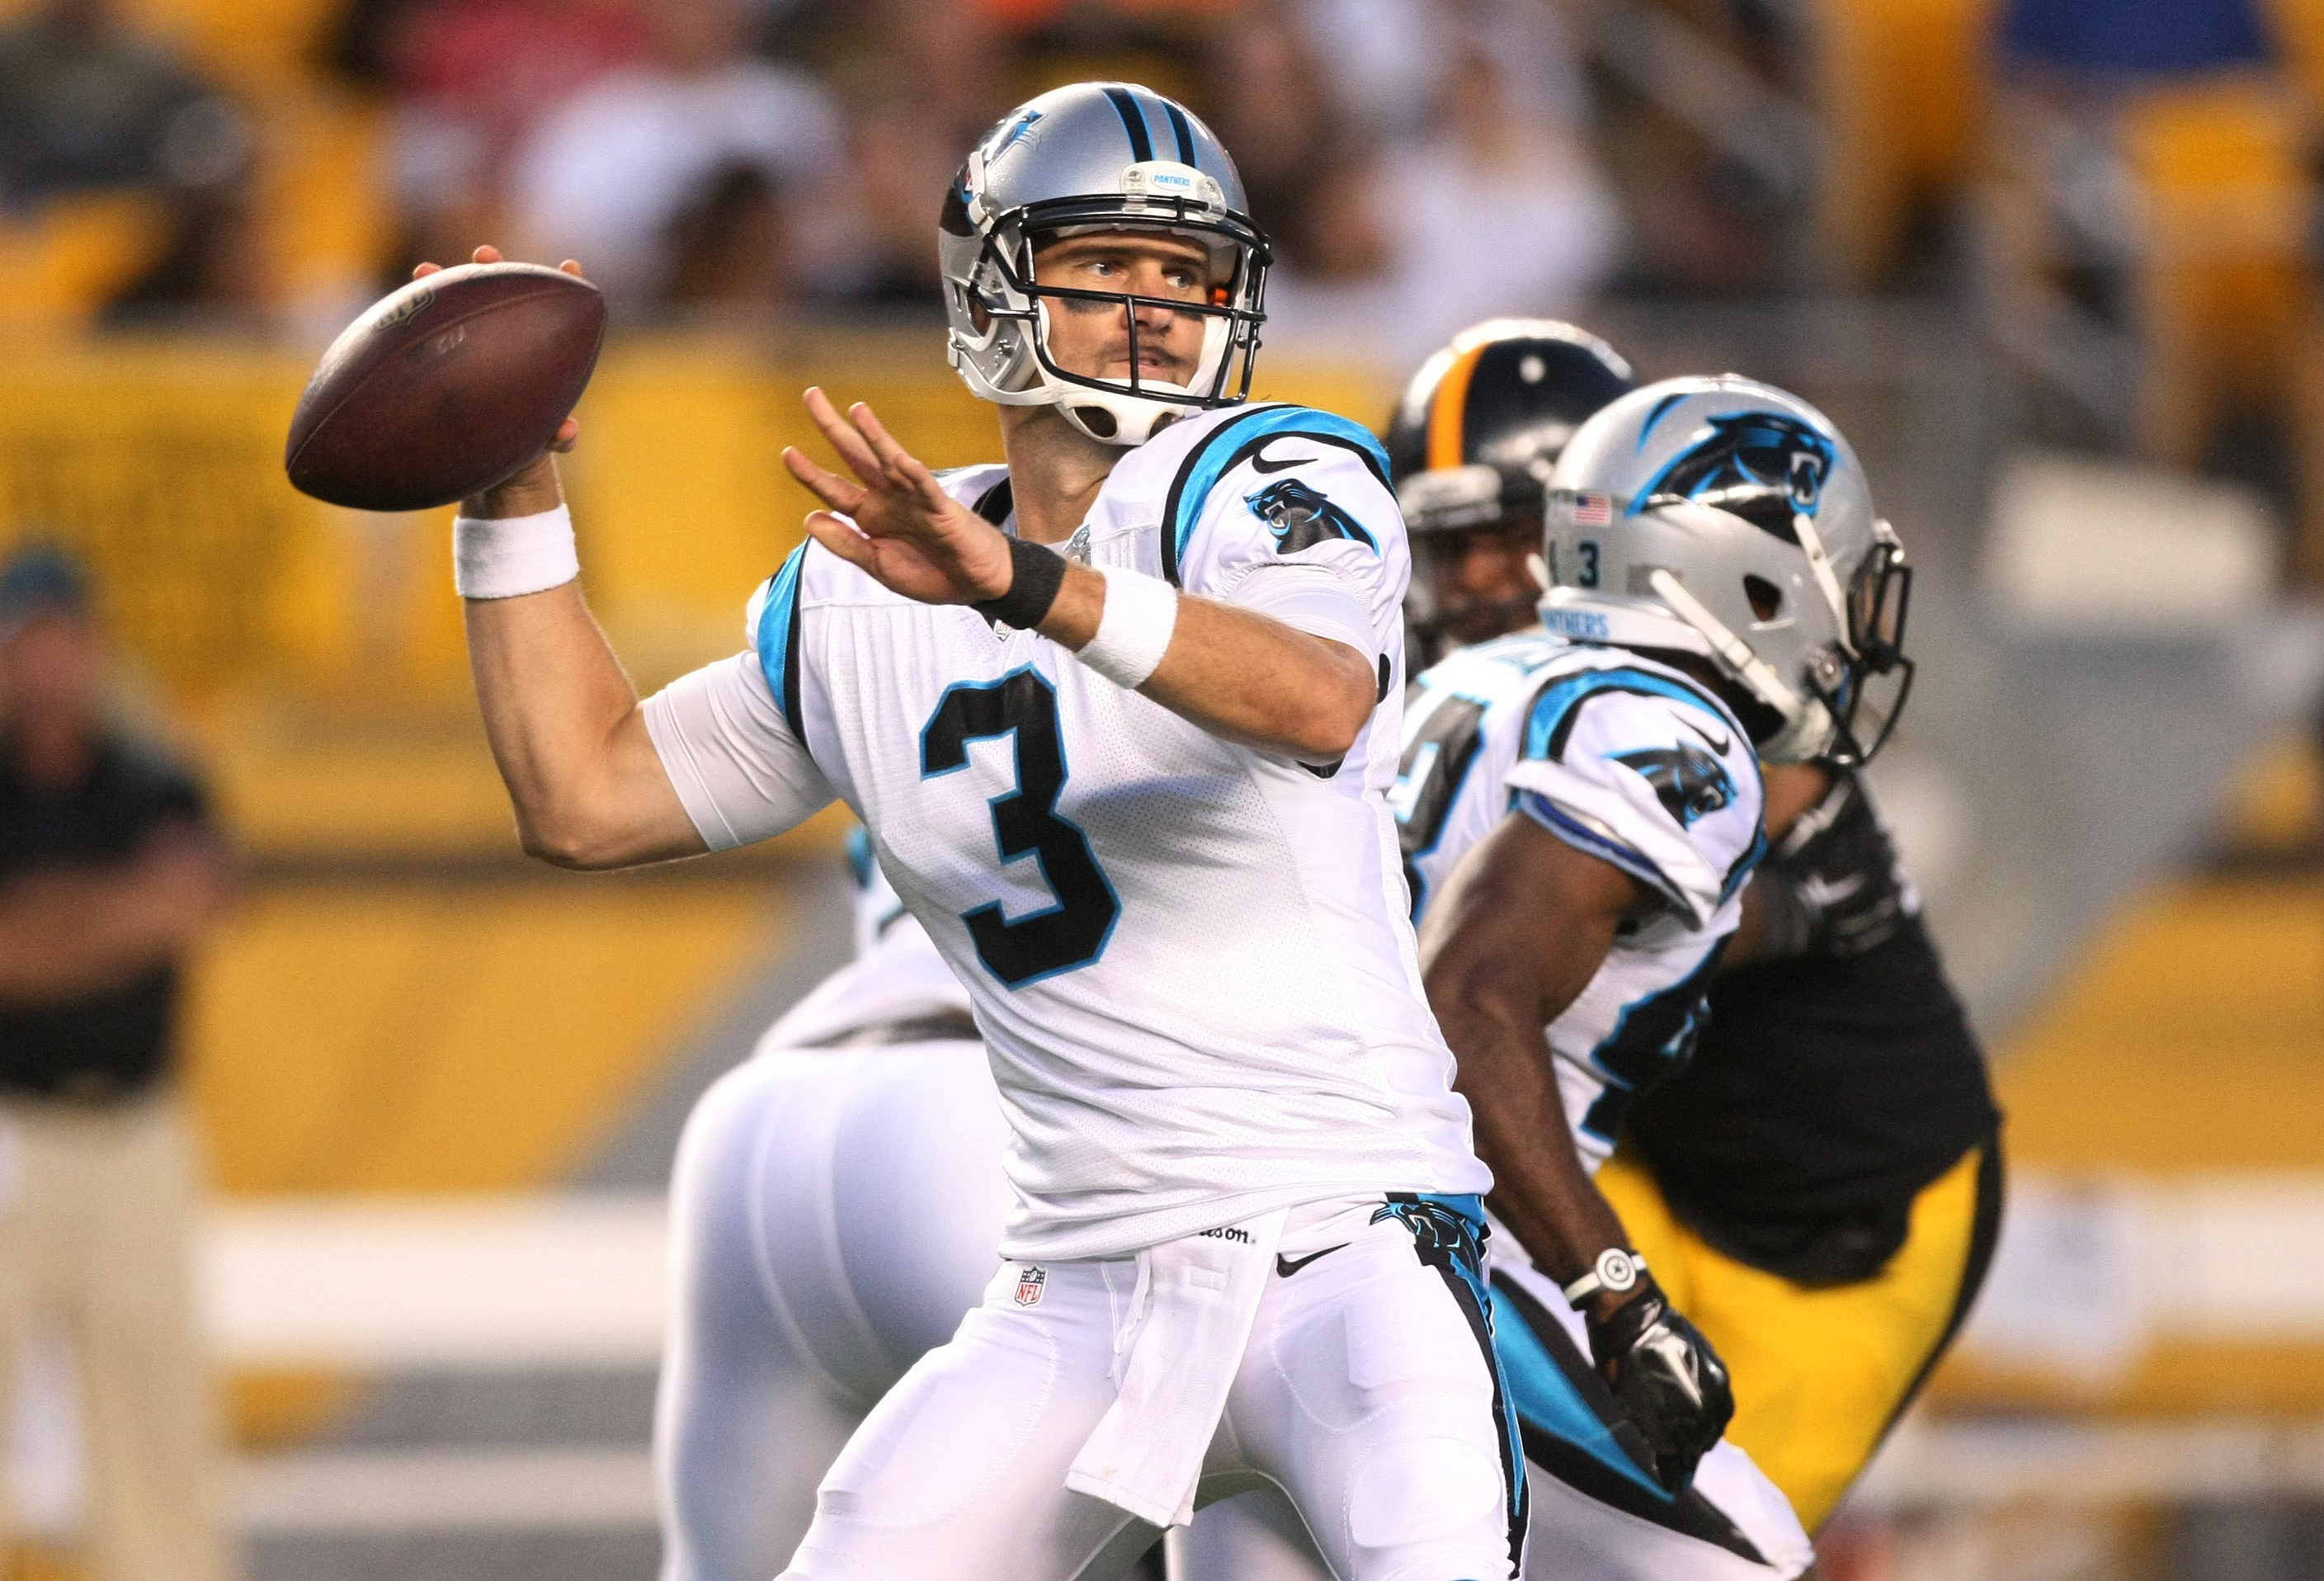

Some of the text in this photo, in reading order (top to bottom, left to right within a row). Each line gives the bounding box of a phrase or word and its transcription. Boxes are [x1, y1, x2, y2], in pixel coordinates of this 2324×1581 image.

[1154, 174, 1190, 186] PANTHERS
[918, 661, 1124, 991] 3
[1016, 1283, 1039, 1302] NFL
